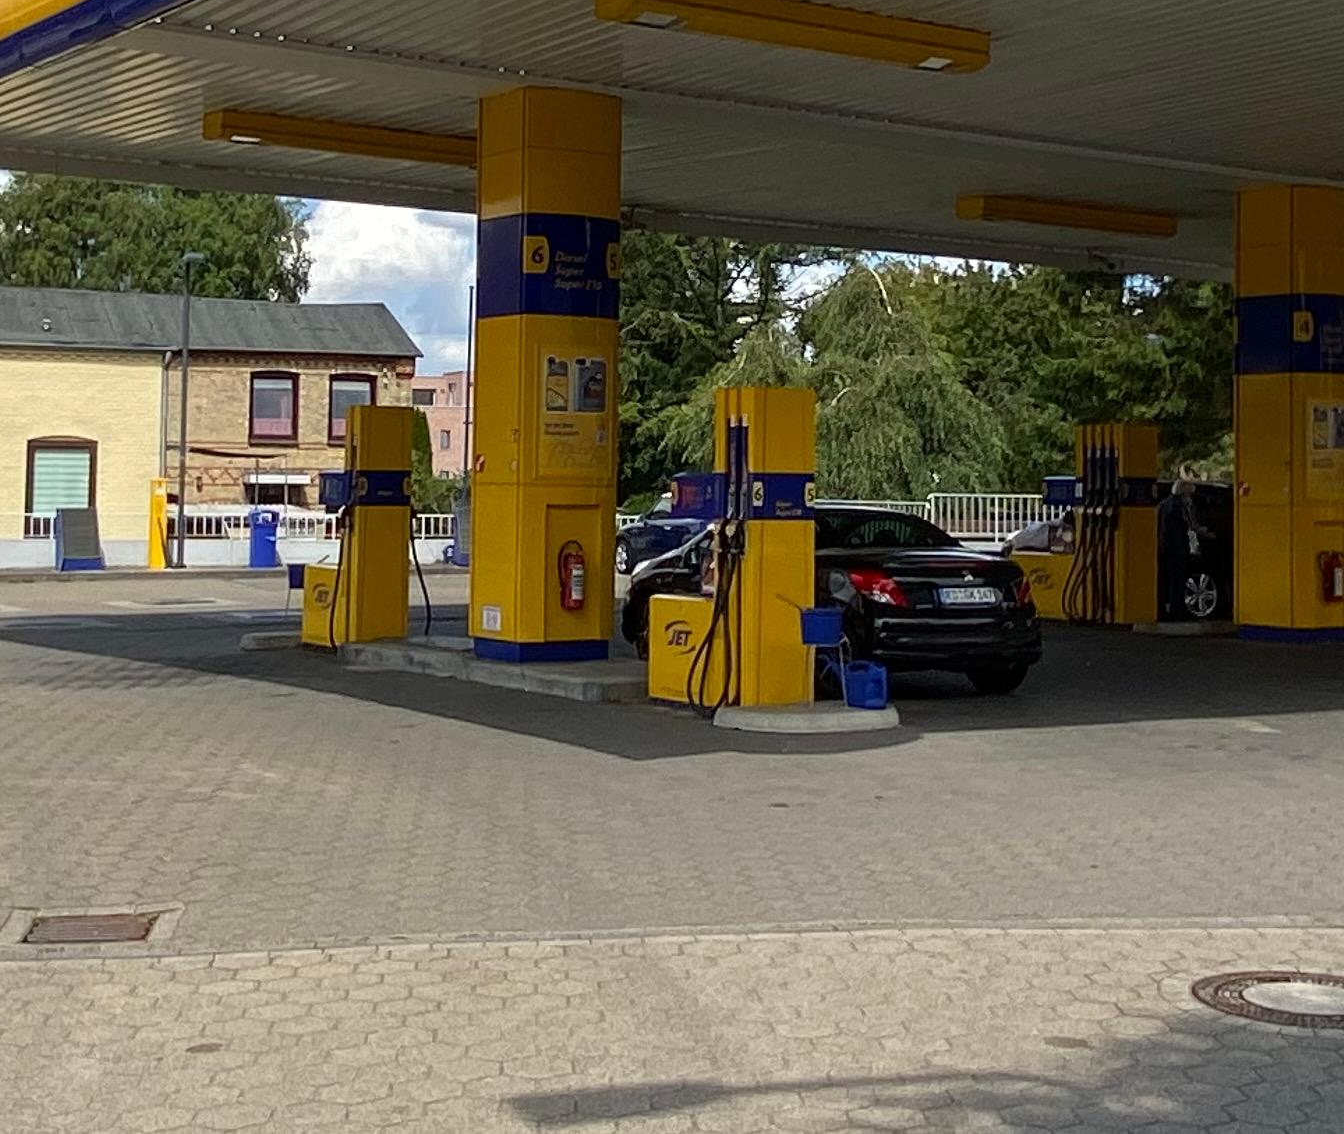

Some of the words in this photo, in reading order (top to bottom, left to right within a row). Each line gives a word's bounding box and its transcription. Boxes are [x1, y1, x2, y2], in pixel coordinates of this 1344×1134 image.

[532, 245, 544, 264] 6
[609, 253, 619, 272] 5
[754, 487, 763, 502] 6
[806, 487, 815, 503] 5
[666, 628, 693, 646] JET
